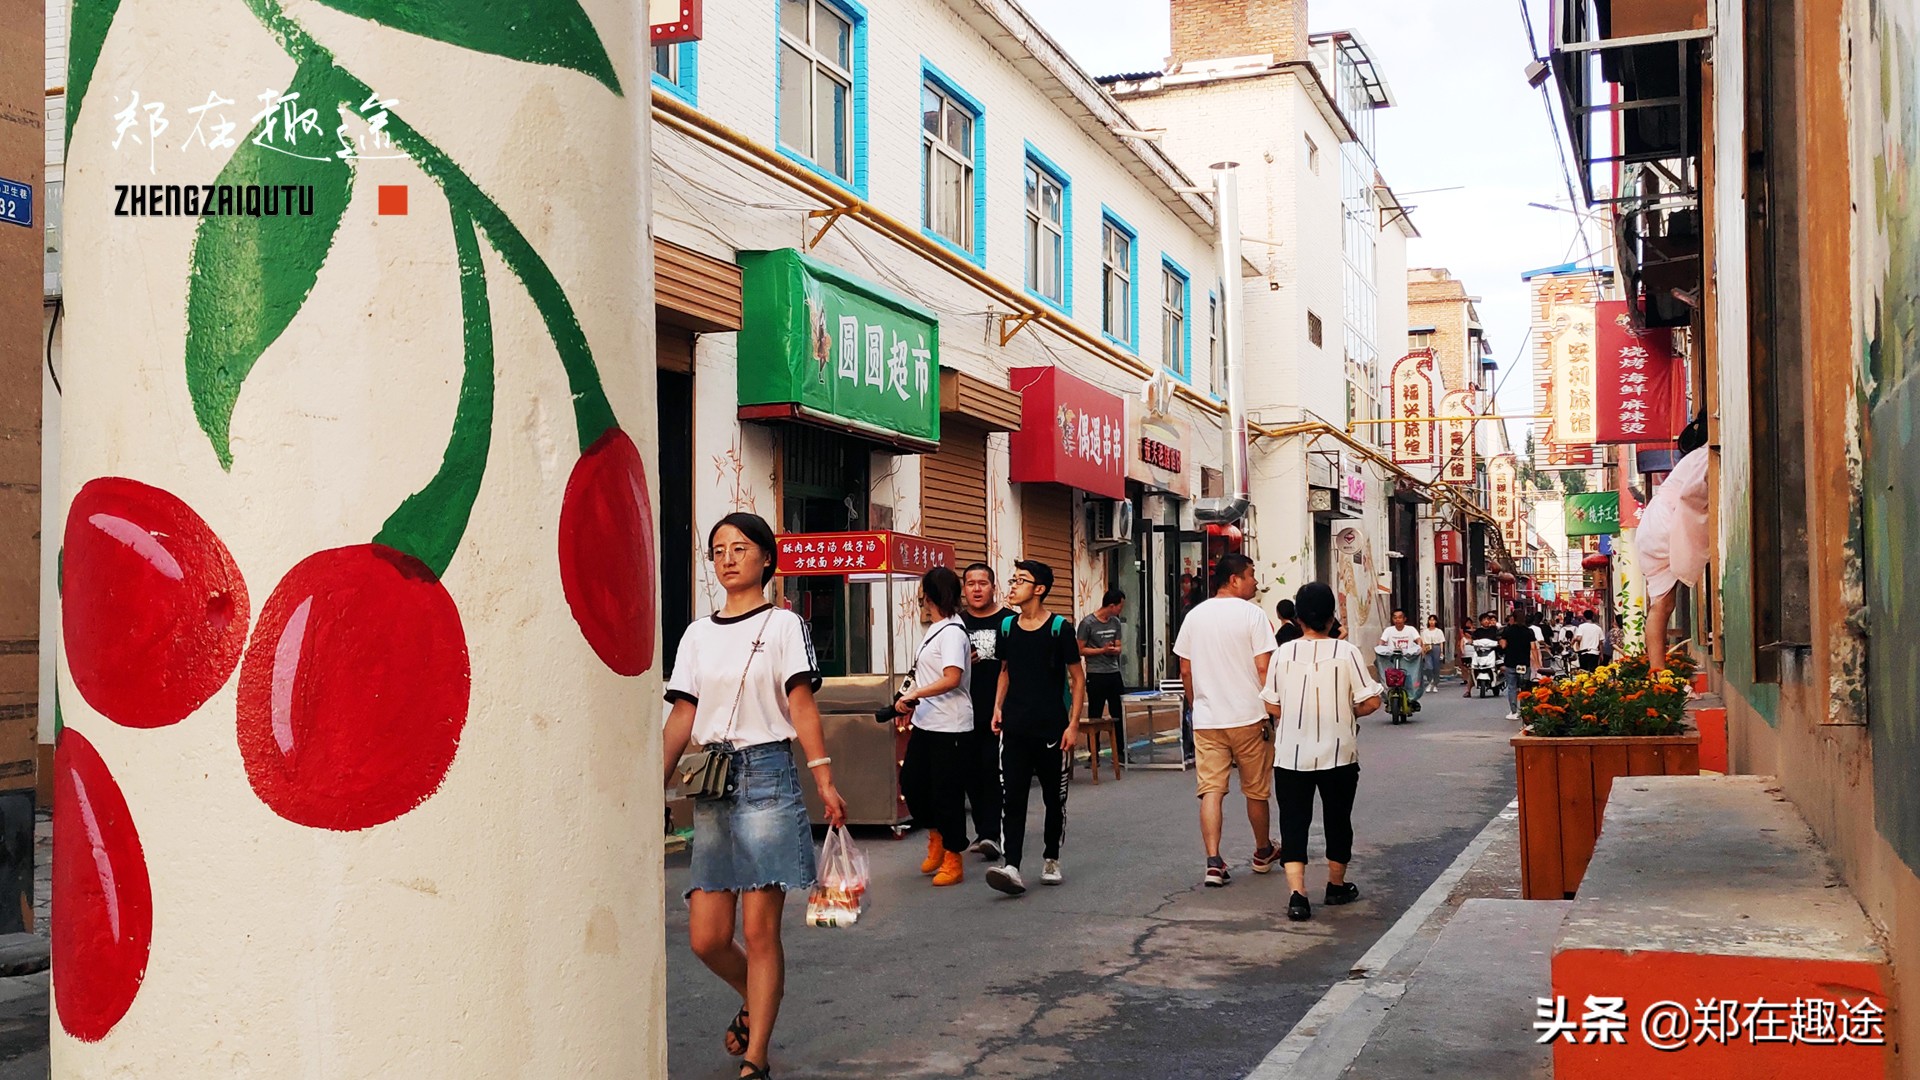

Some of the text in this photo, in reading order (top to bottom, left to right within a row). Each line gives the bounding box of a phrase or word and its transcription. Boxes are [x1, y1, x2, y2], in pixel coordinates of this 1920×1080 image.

[838, 314, 931, 411] 圆圆超市
[1618, 345, 1650, 434] 烧烤 海鲜 麻辣烫
[1077, 407, 1121, 477] 偶遇串串
[1403, 384, 1420, 456] 福兴旅馆
[782, 540, 876, 554] 酥肉丸子汤 饺子汤
[794, 555, 867, 569] 方便面 炒大米
